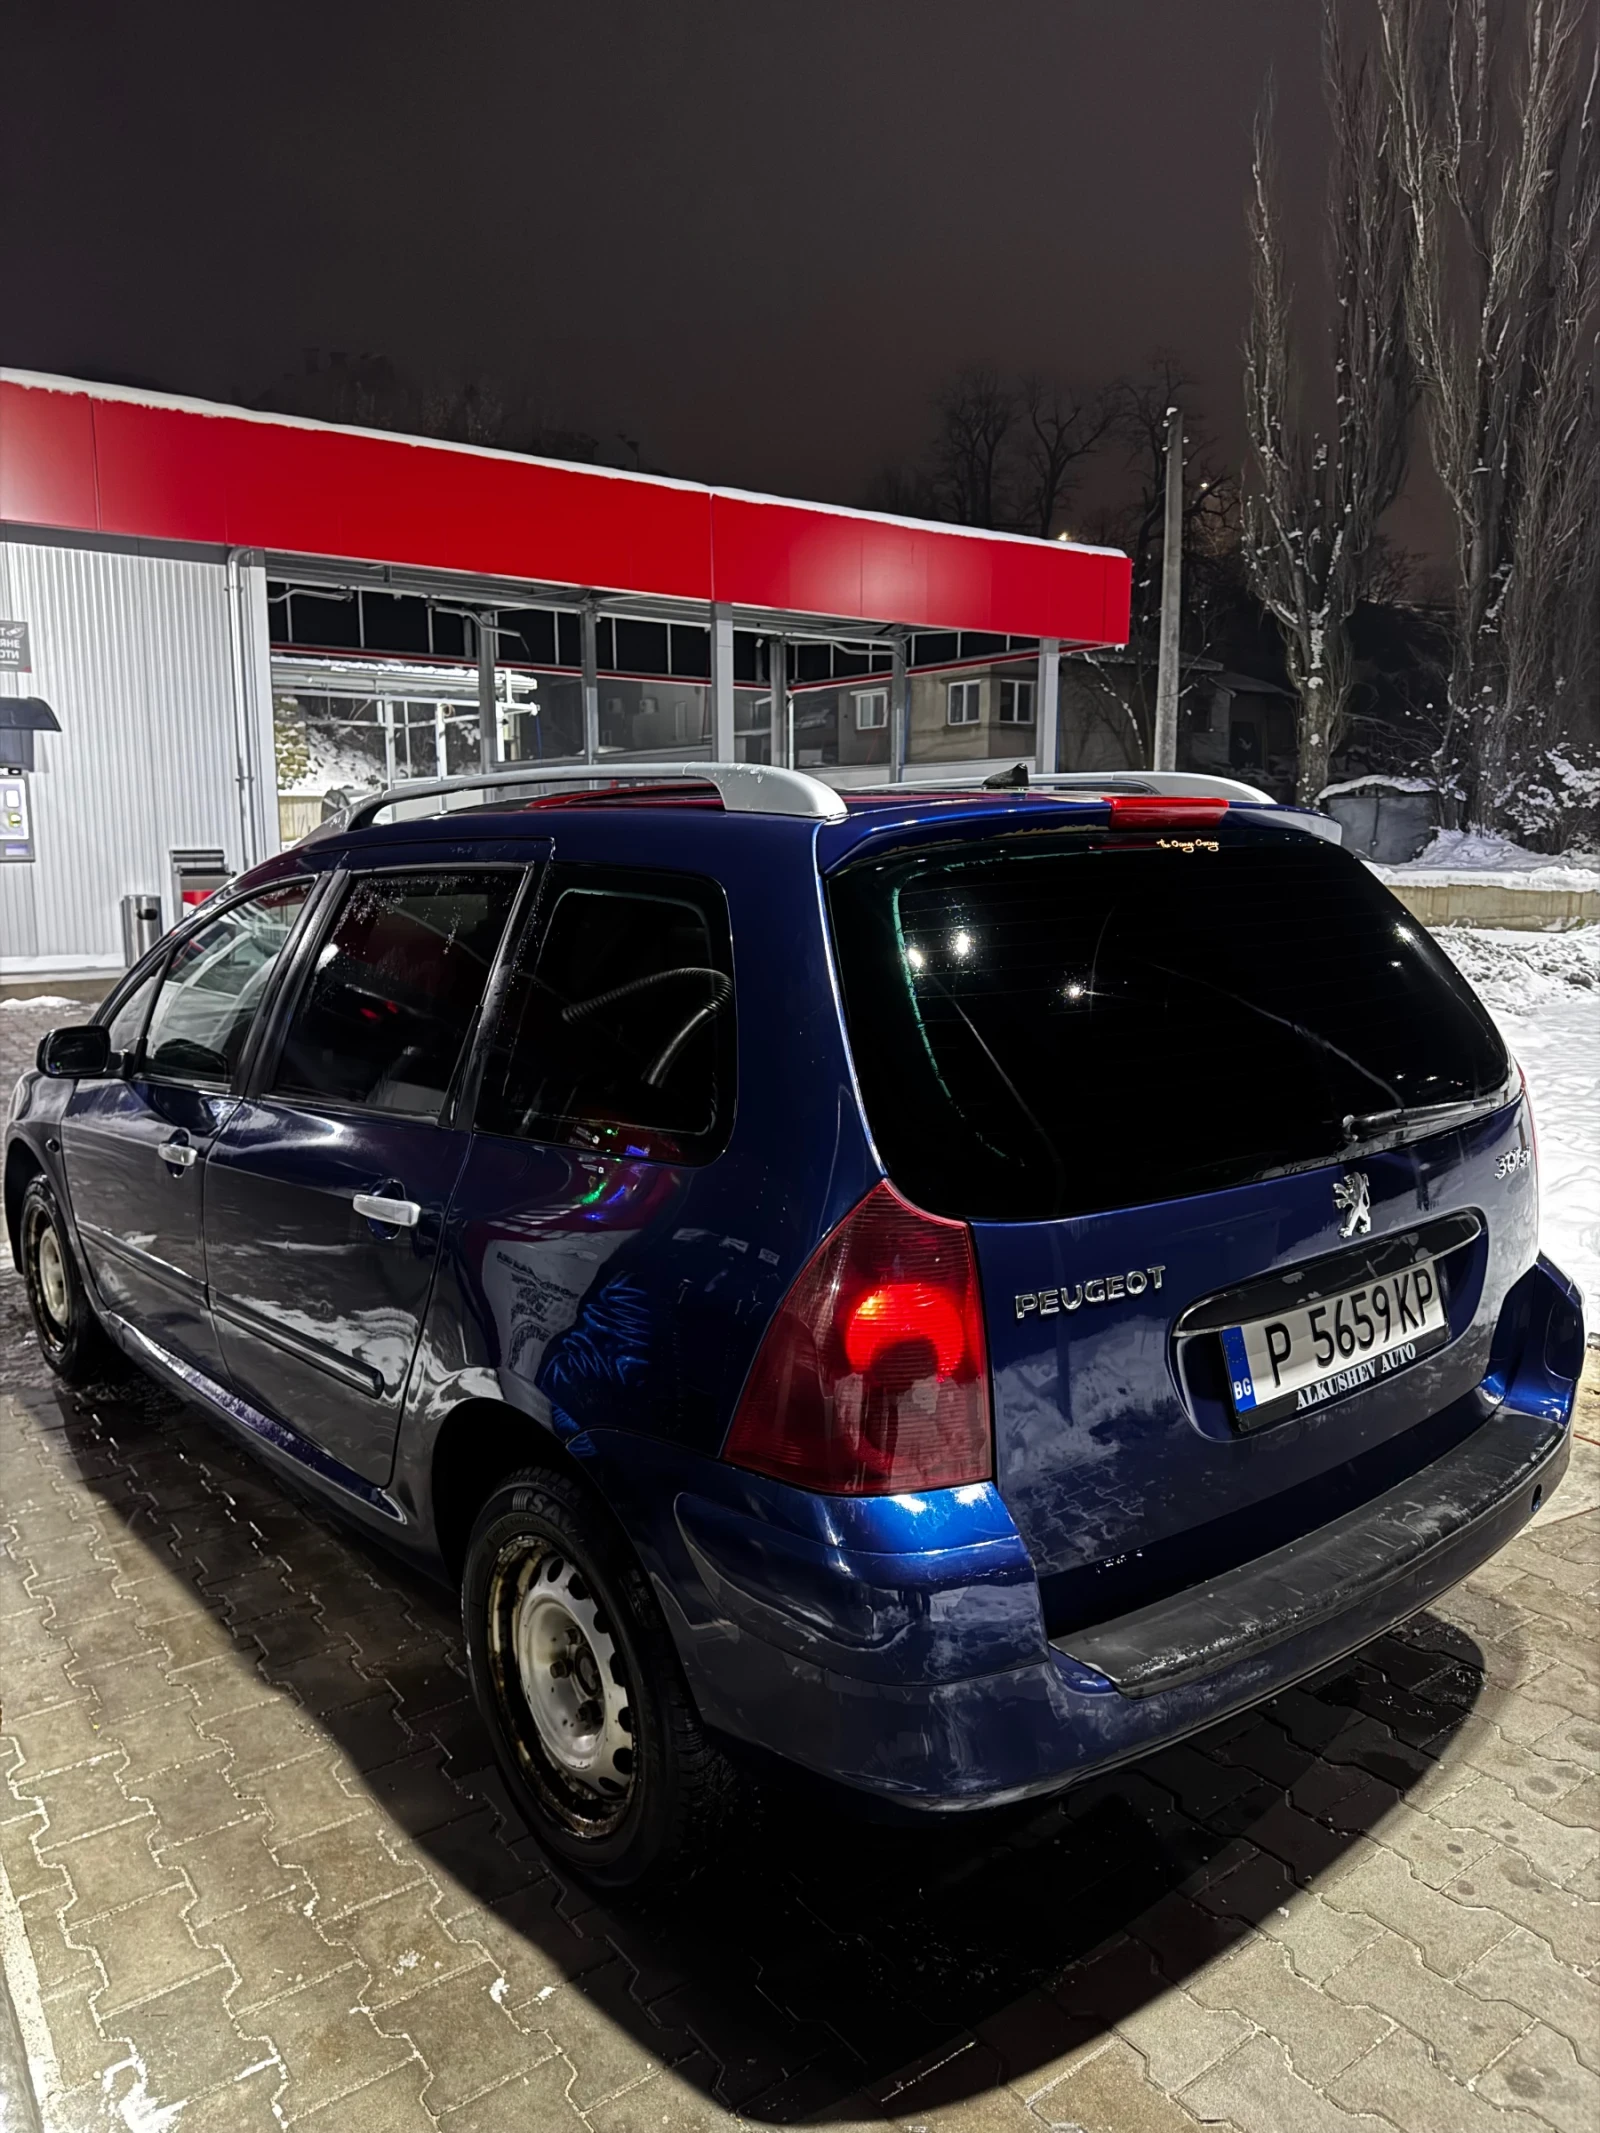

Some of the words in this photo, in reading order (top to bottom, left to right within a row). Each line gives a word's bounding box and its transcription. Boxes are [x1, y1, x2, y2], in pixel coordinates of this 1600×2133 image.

[1014, 1265, 1166, 1319] PEUGEOT
[1233, 1377, 1252, 1400] BG
[1296, 1360, 1376, 1411] ALKUSHEV
[1381, 1342, 1417, 1373] AUTO
